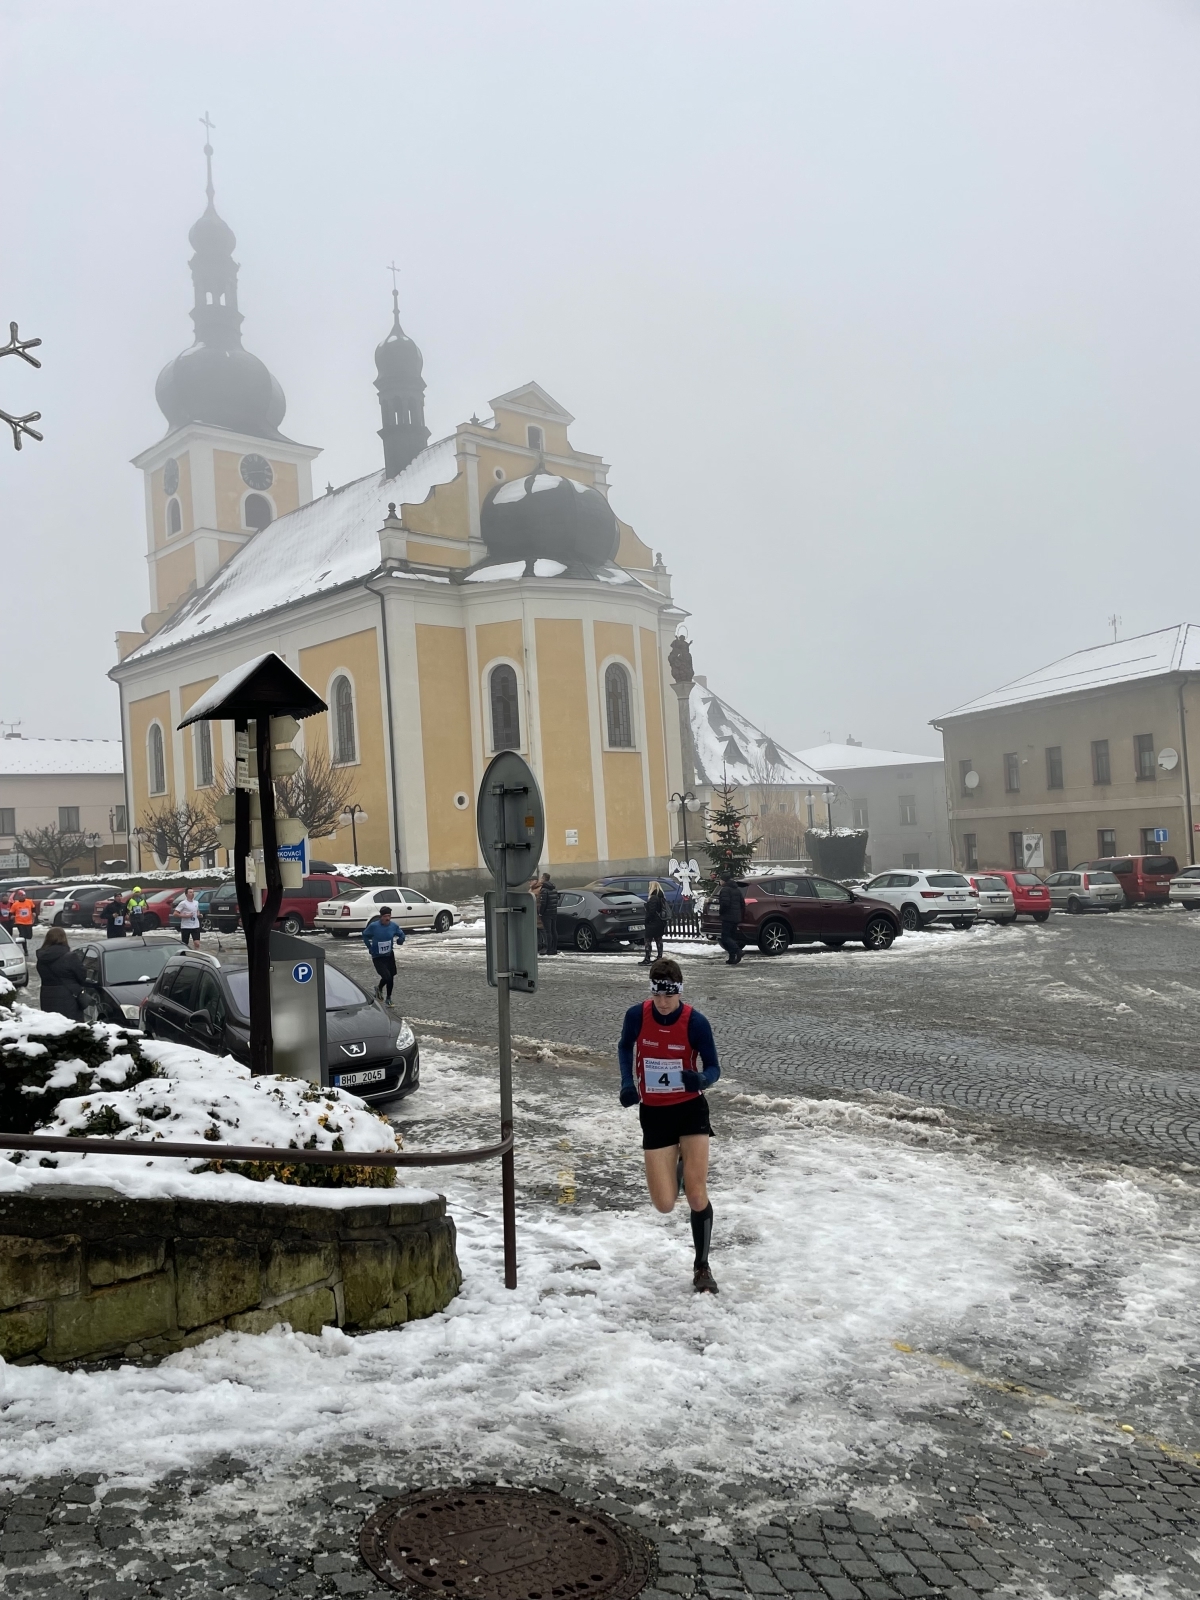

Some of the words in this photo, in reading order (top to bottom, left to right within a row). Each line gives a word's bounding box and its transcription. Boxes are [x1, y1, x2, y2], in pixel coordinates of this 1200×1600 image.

[298, 966, 309, 980] P
[363, 1071, 382, 1081] 2045
[658, 1073, 670, 1086] 4
